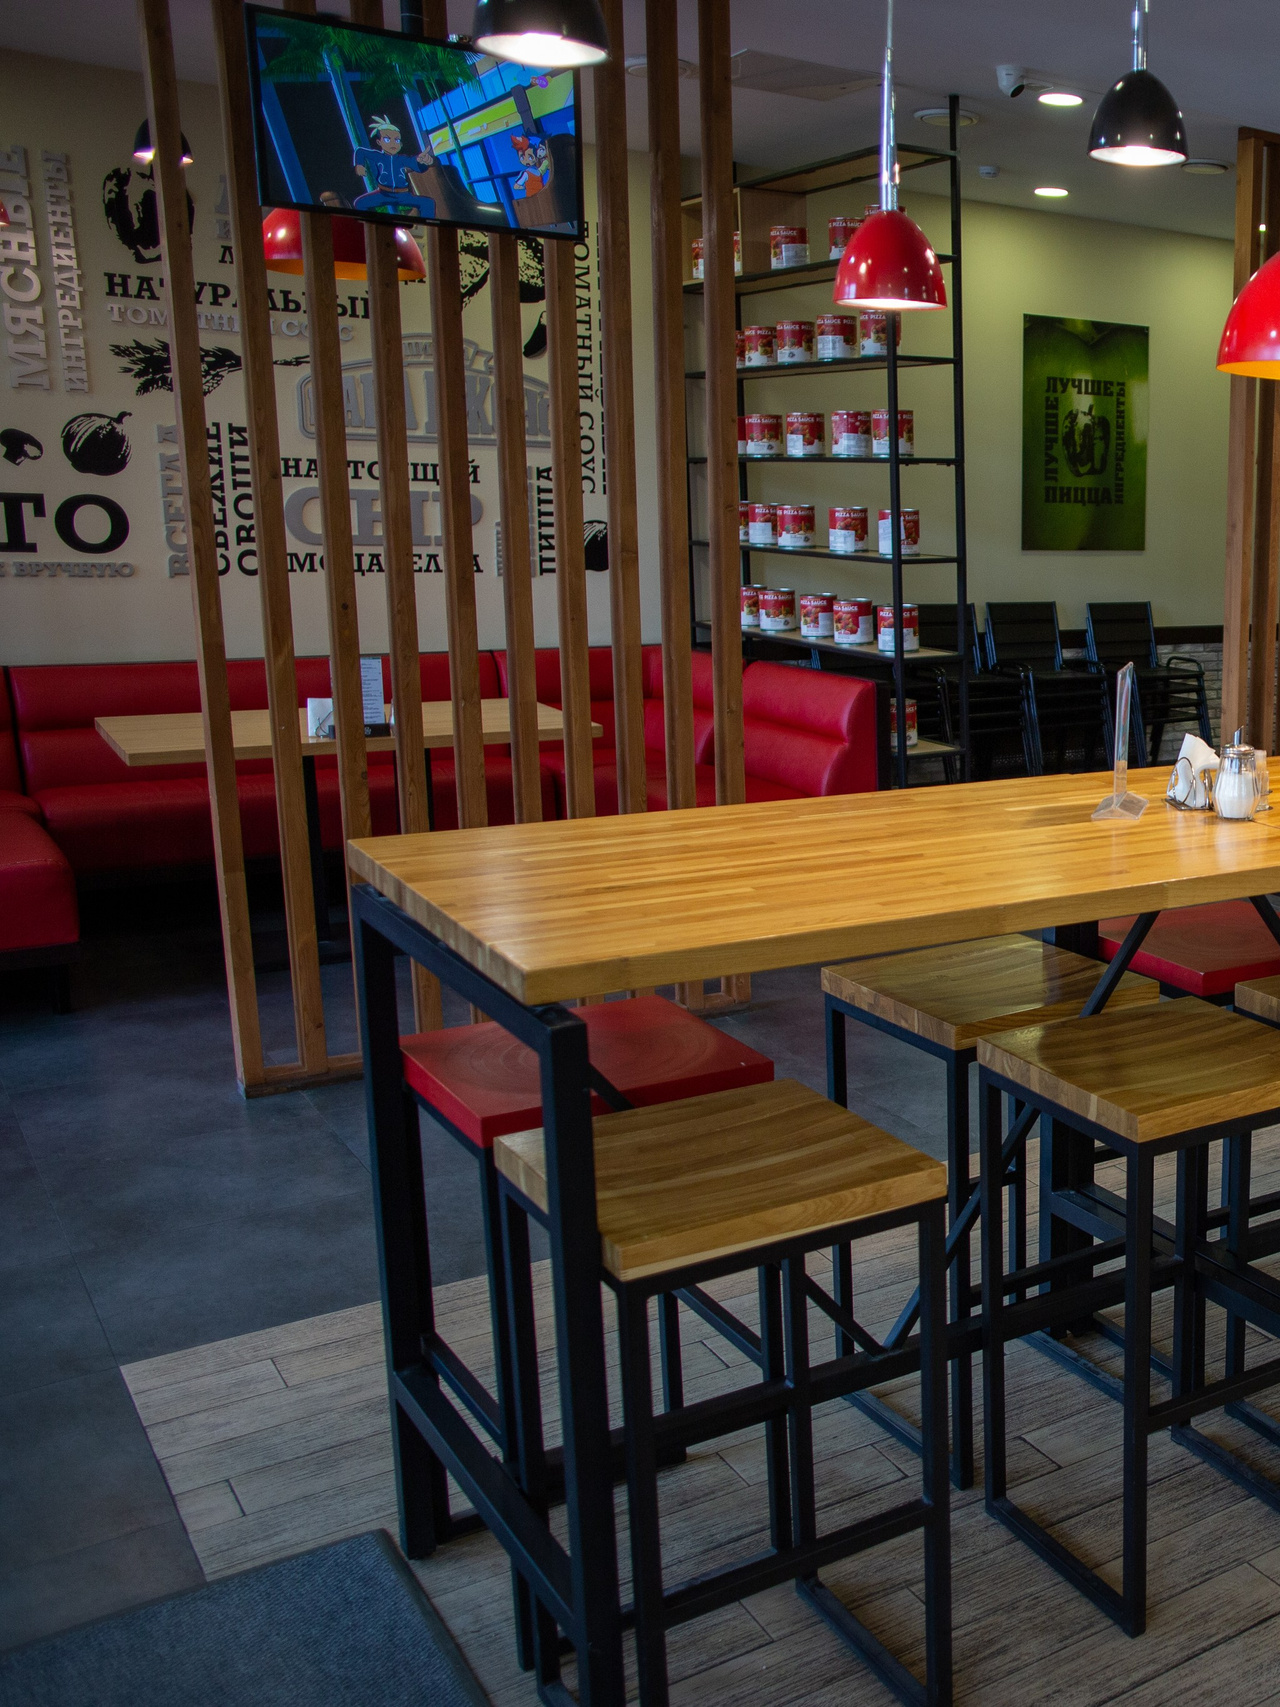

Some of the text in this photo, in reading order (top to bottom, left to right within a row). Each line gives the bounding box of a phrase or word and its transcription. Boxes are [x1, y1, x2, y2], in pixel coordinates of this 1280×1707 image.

[41, 150, 89, 393] ИНГРЕДИЕНТЫ
[1045, 376, 1114, 397] ЛУЧШЕ
[1044, 396, 1059, 483] ЛУЧШЕ
[1044, 486, 1113, 506] ПИЦЦА
[14, 561, 135, 578] ВРУЧНУЮ
